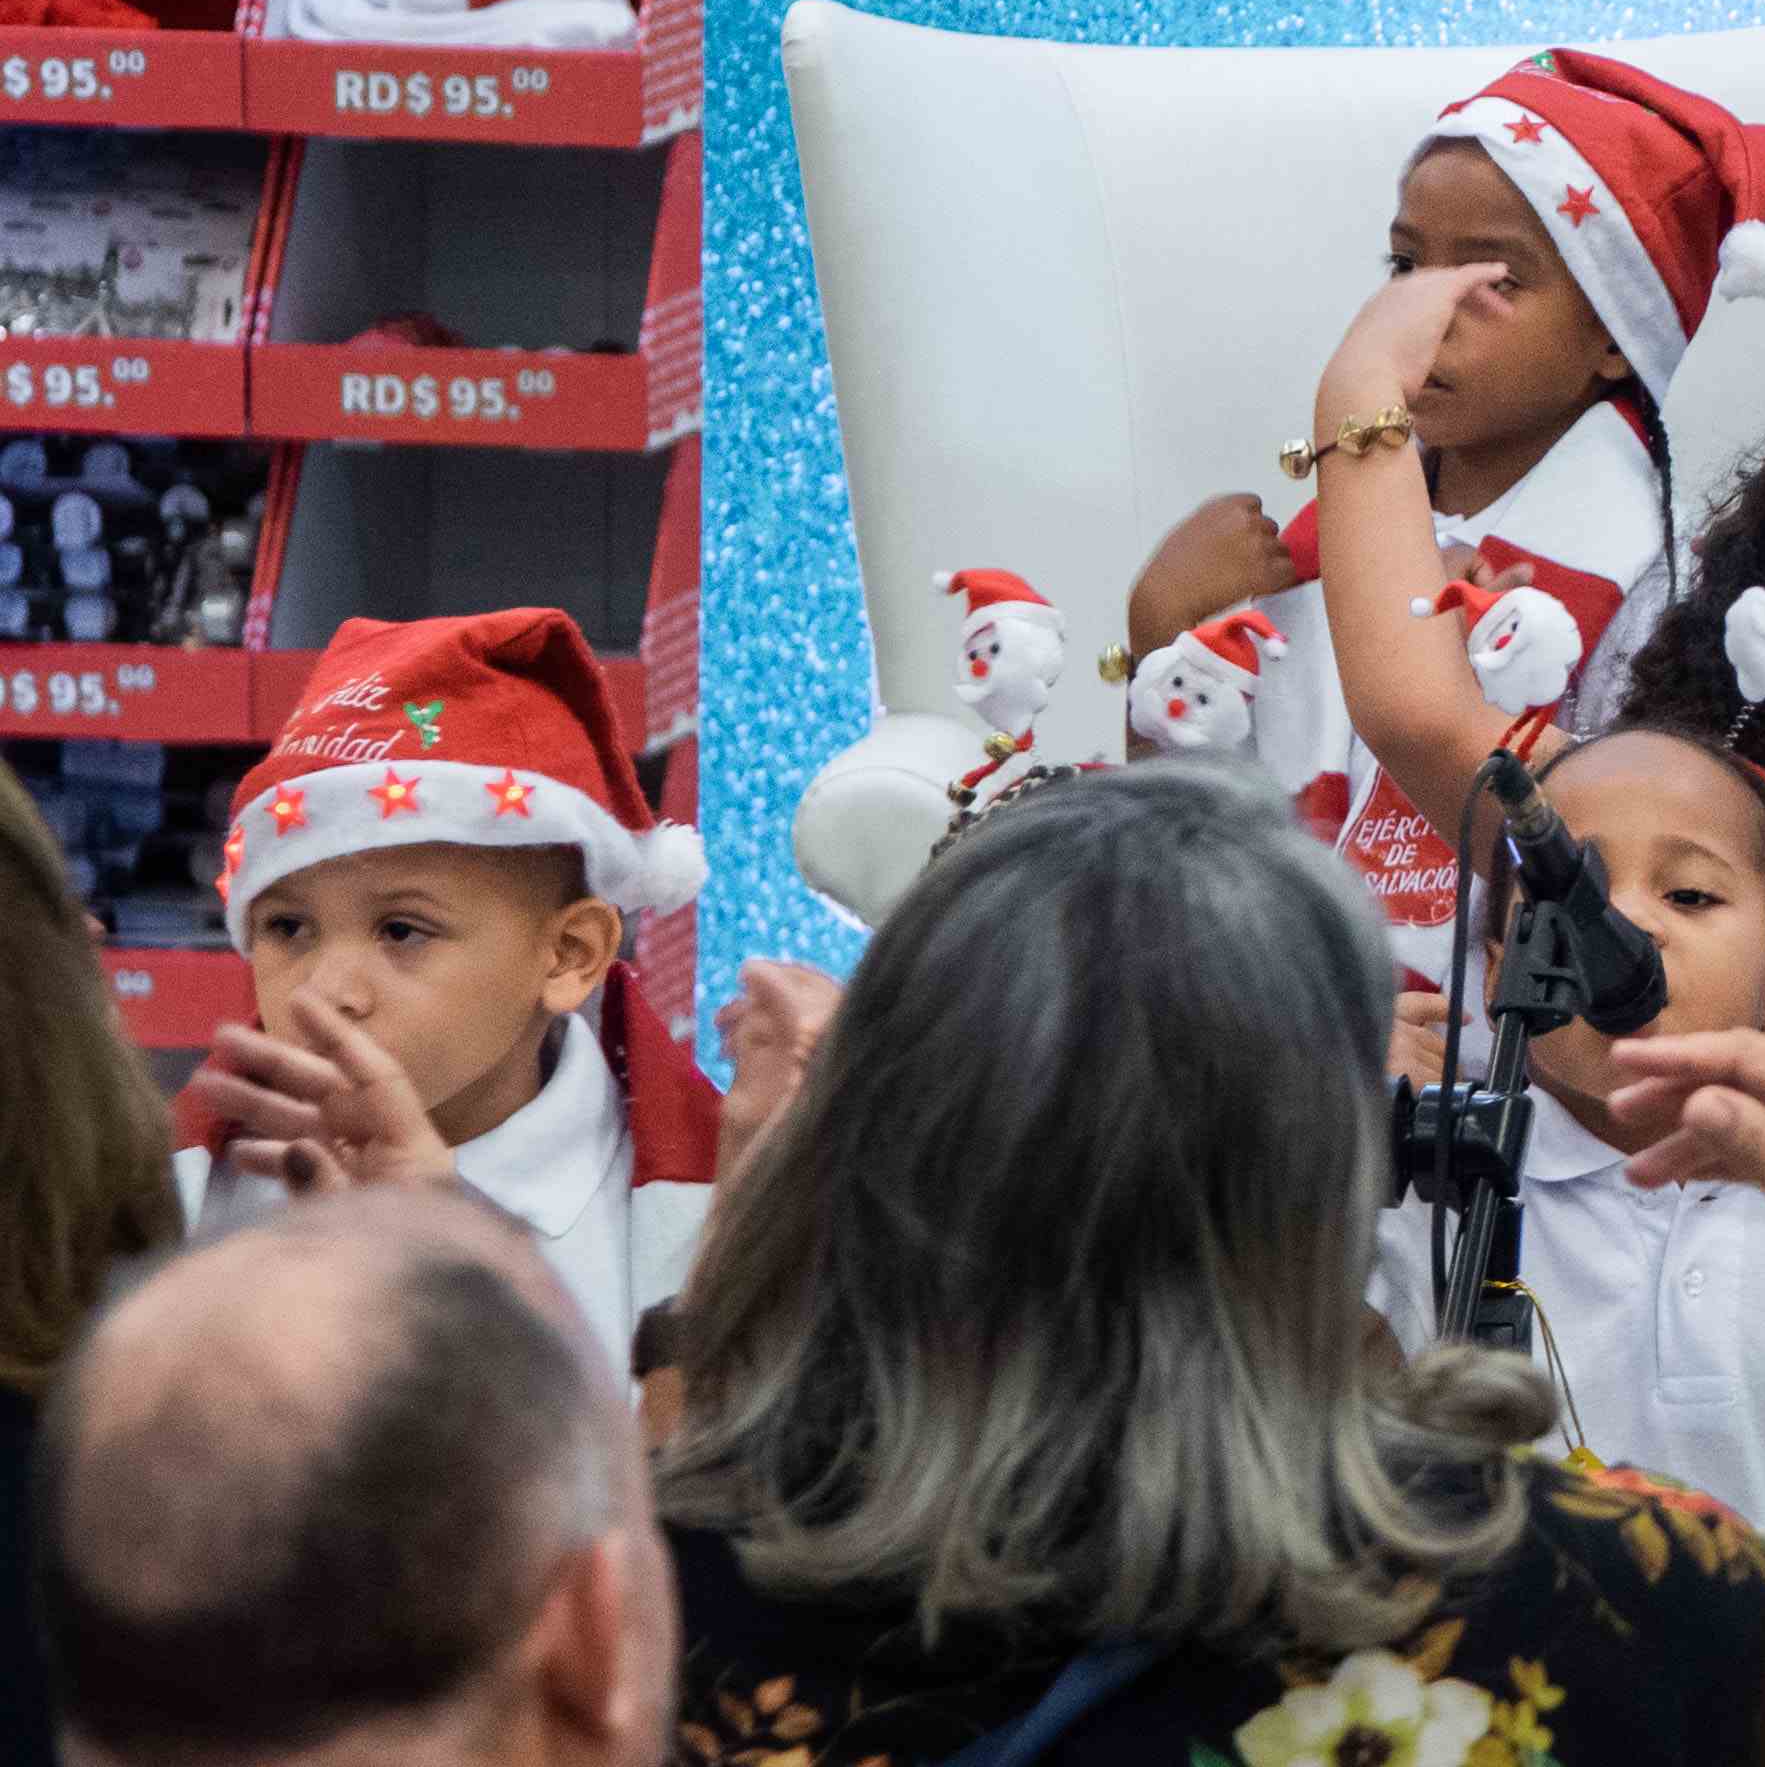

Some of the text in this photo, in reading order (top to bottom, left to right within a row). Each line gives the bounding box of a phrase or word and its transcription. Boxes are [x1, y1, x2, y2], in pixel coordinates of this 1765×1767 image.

[335, 69, 433, 116] RD$
[341, 371, 438, 421] RD$
[1356, 809, 1436, 849] EJÉRCI
[1384, 843, 1417, 867] DE
